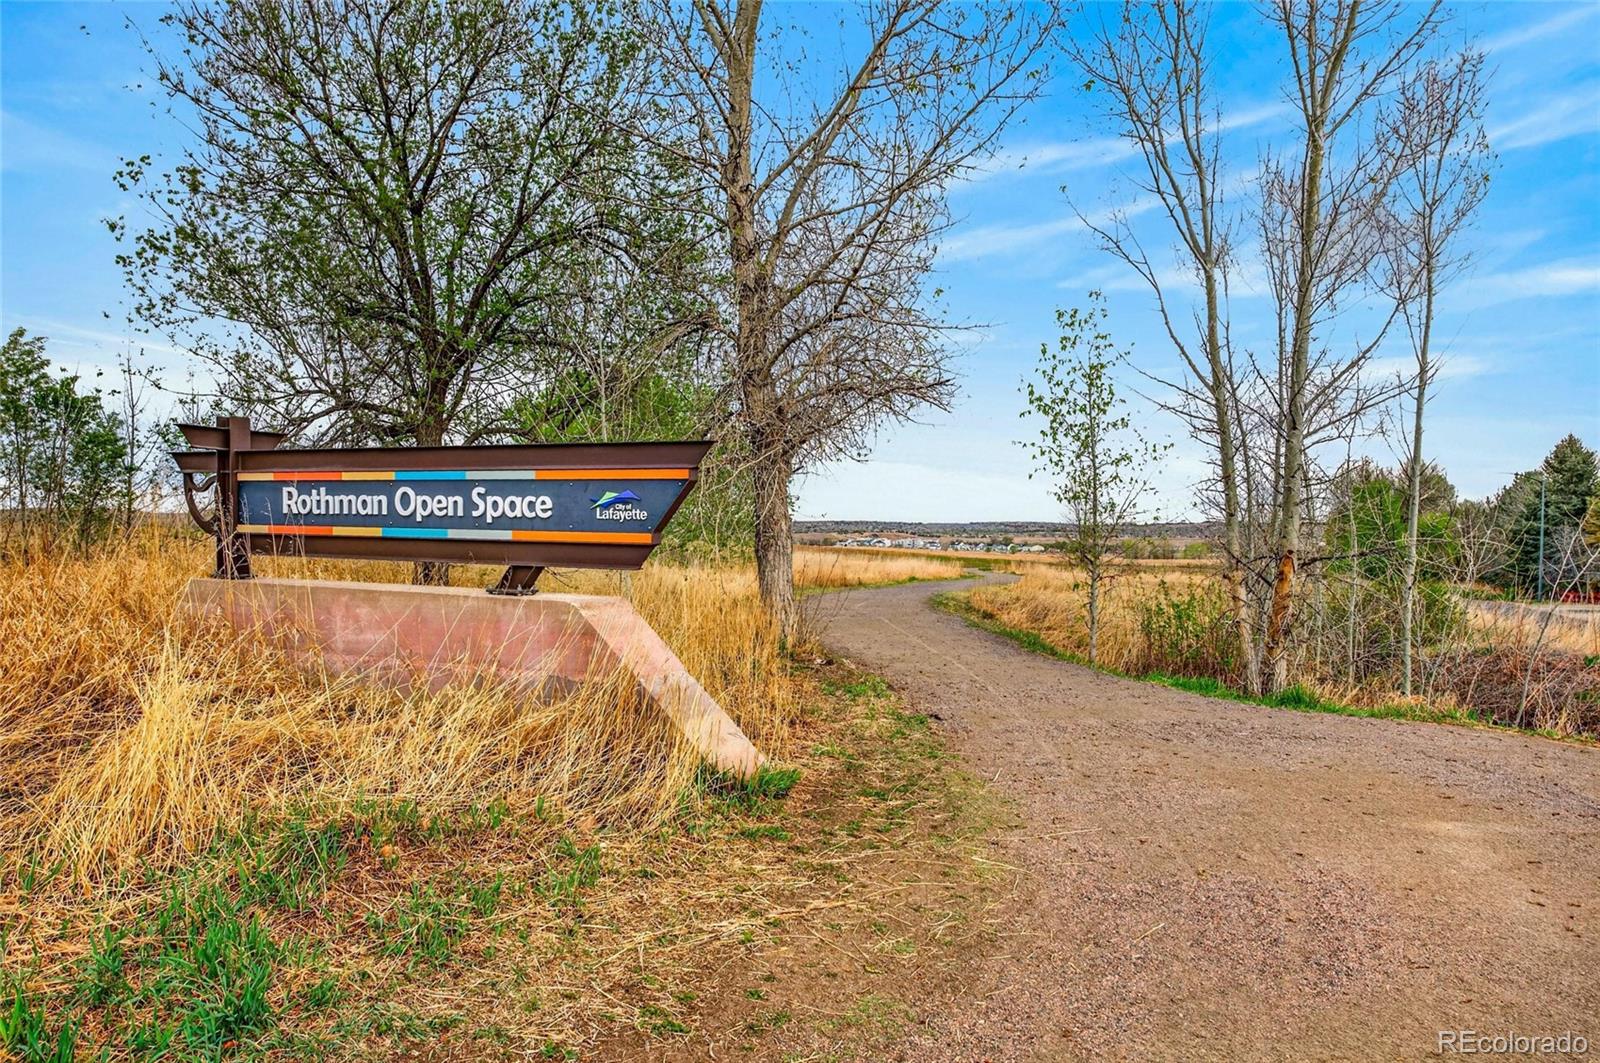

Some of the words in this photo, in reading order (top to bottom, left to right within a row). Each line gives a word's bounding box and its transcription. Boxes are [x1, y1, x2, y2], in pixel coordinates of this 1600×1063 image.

[281, 486, 388, 516] Rothman
[394, 486, 464, 522] Open
[471, 486, 553, 523] Space
[615, 503, 625, 511] City
[596, 507, 648, 522] Lafayette
